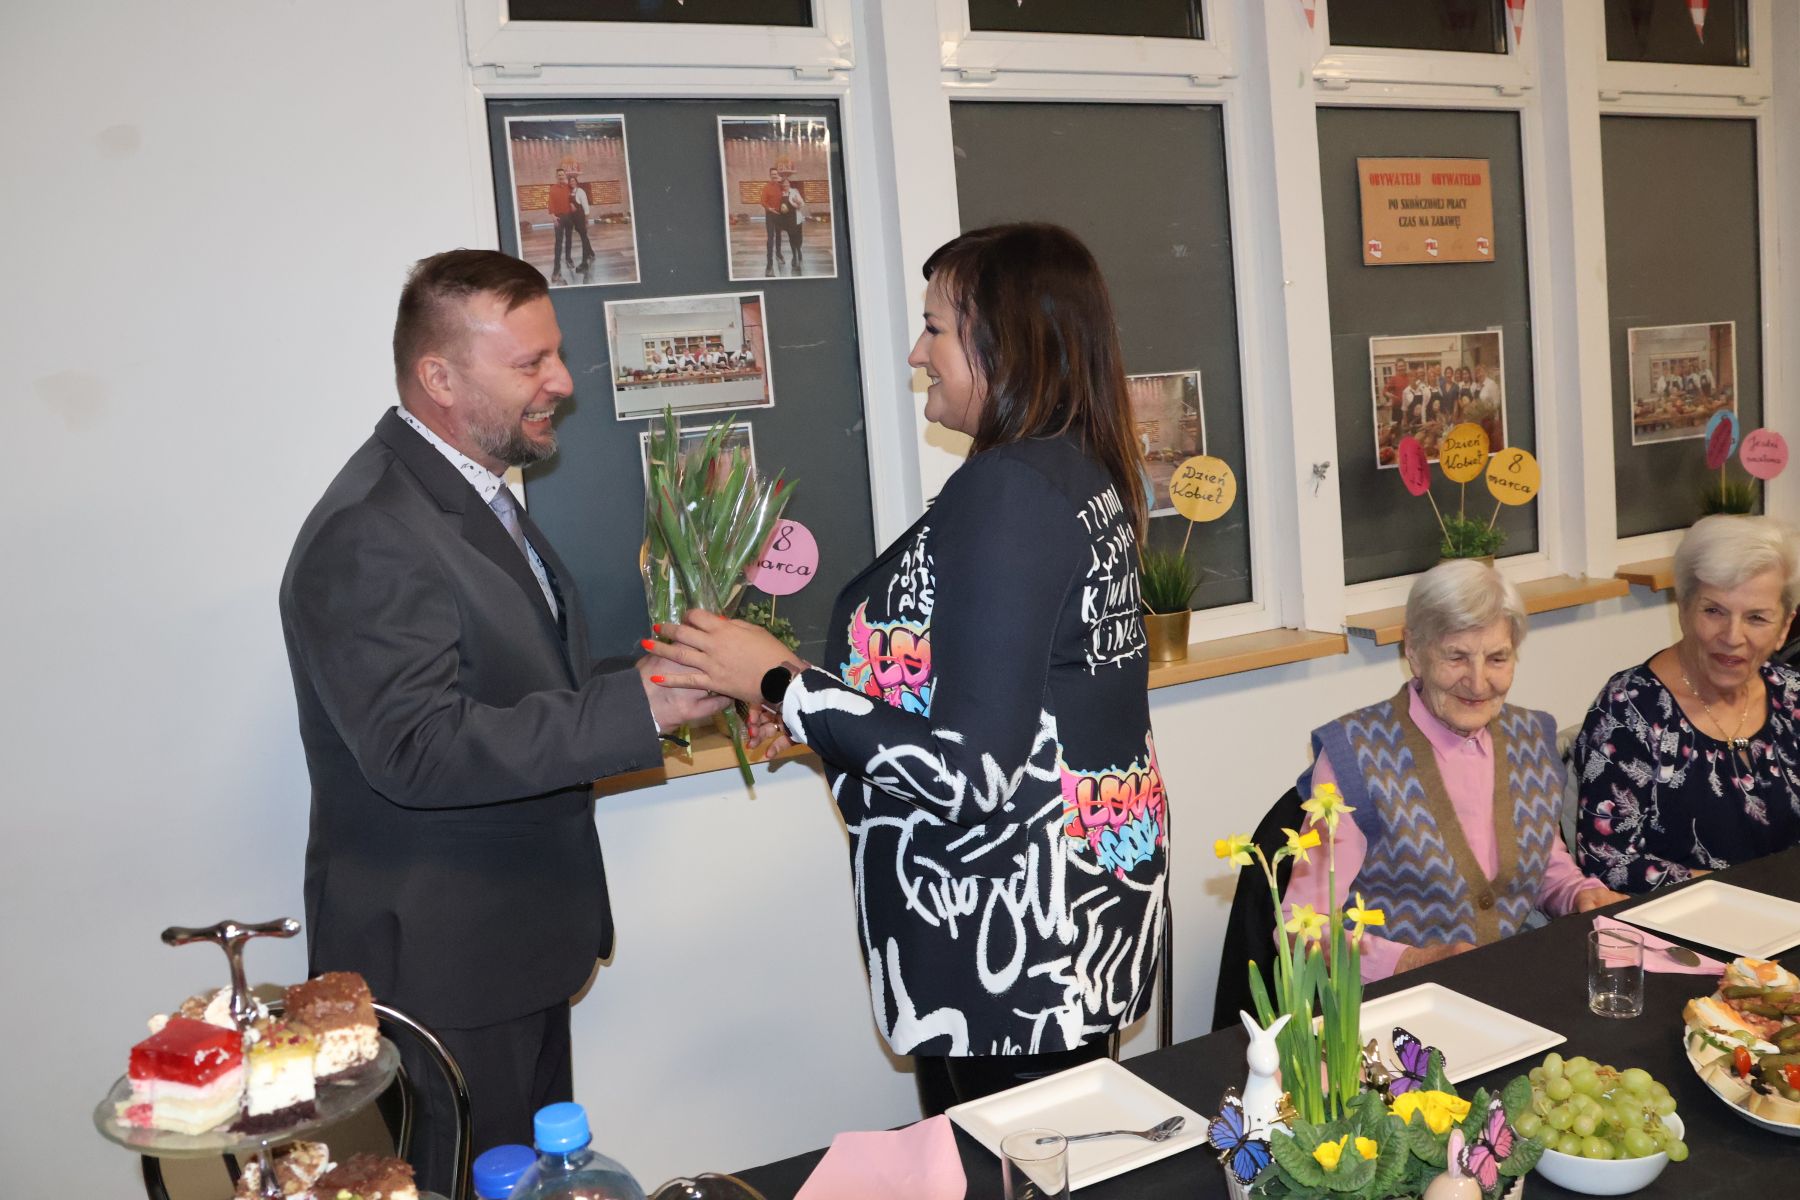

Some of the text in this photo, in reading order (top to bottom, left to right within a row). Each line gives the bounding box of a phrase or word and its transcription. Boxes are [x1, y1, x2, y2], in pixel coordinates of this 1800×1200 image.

[1398, 216, 1416, 228] CZAS
[1419, 216, 1429, 227] NA
[1444, 434, 1481, 451] Dzień
[1508, 454, 1524, 474] 8
[1182, 466, 1228, 487] Dzień
[1488, 475, 1532, 494] marca
[1171, 481, 1222, 504] Kobiet
[772, 525, 794, 552] 8
[1076, 766, 1163, 828] LOVE
